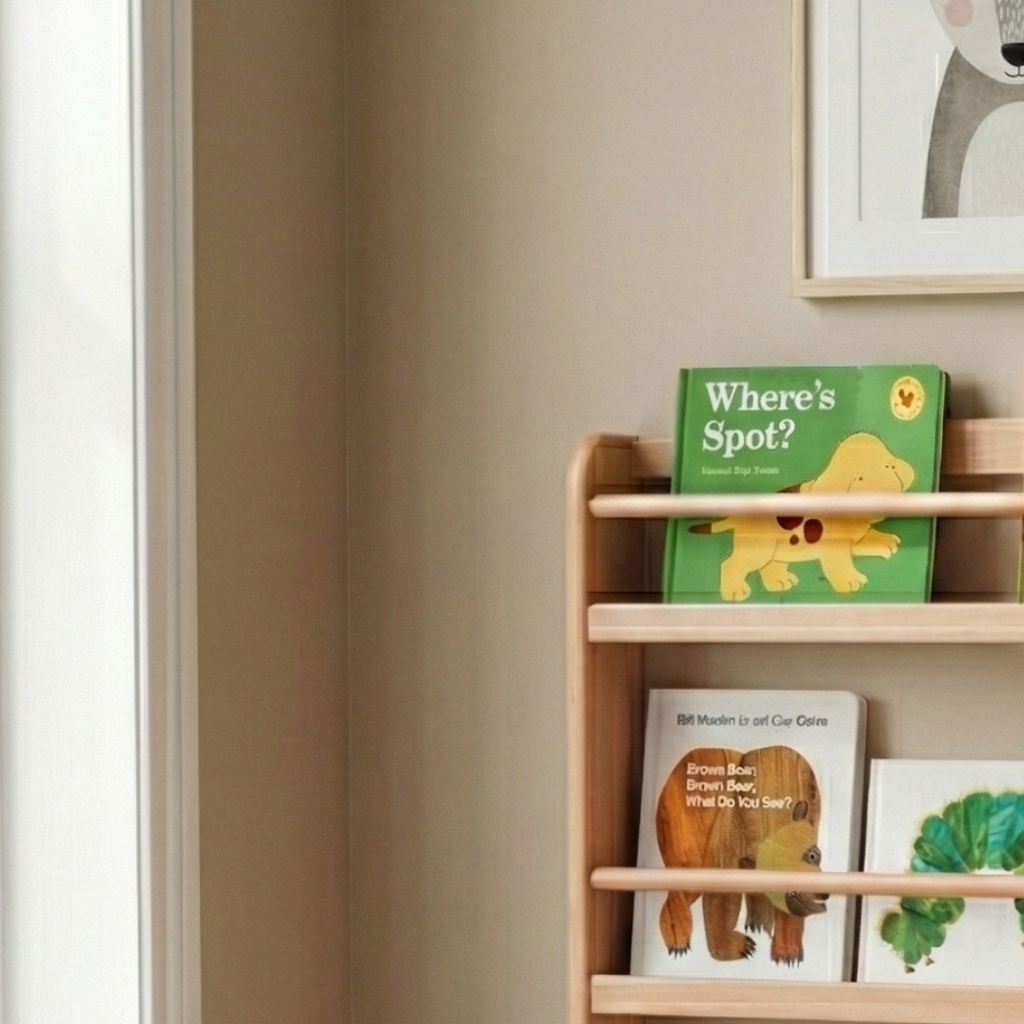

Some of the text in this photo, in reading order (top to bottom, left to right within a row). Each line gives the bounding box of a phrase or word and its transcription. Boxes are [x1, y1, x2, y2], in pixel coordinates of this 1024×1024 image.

[705, 378, 835, 412] Where's
[702, 418, 796, 458] Spot?
[718, 796, 735, 808] Do
